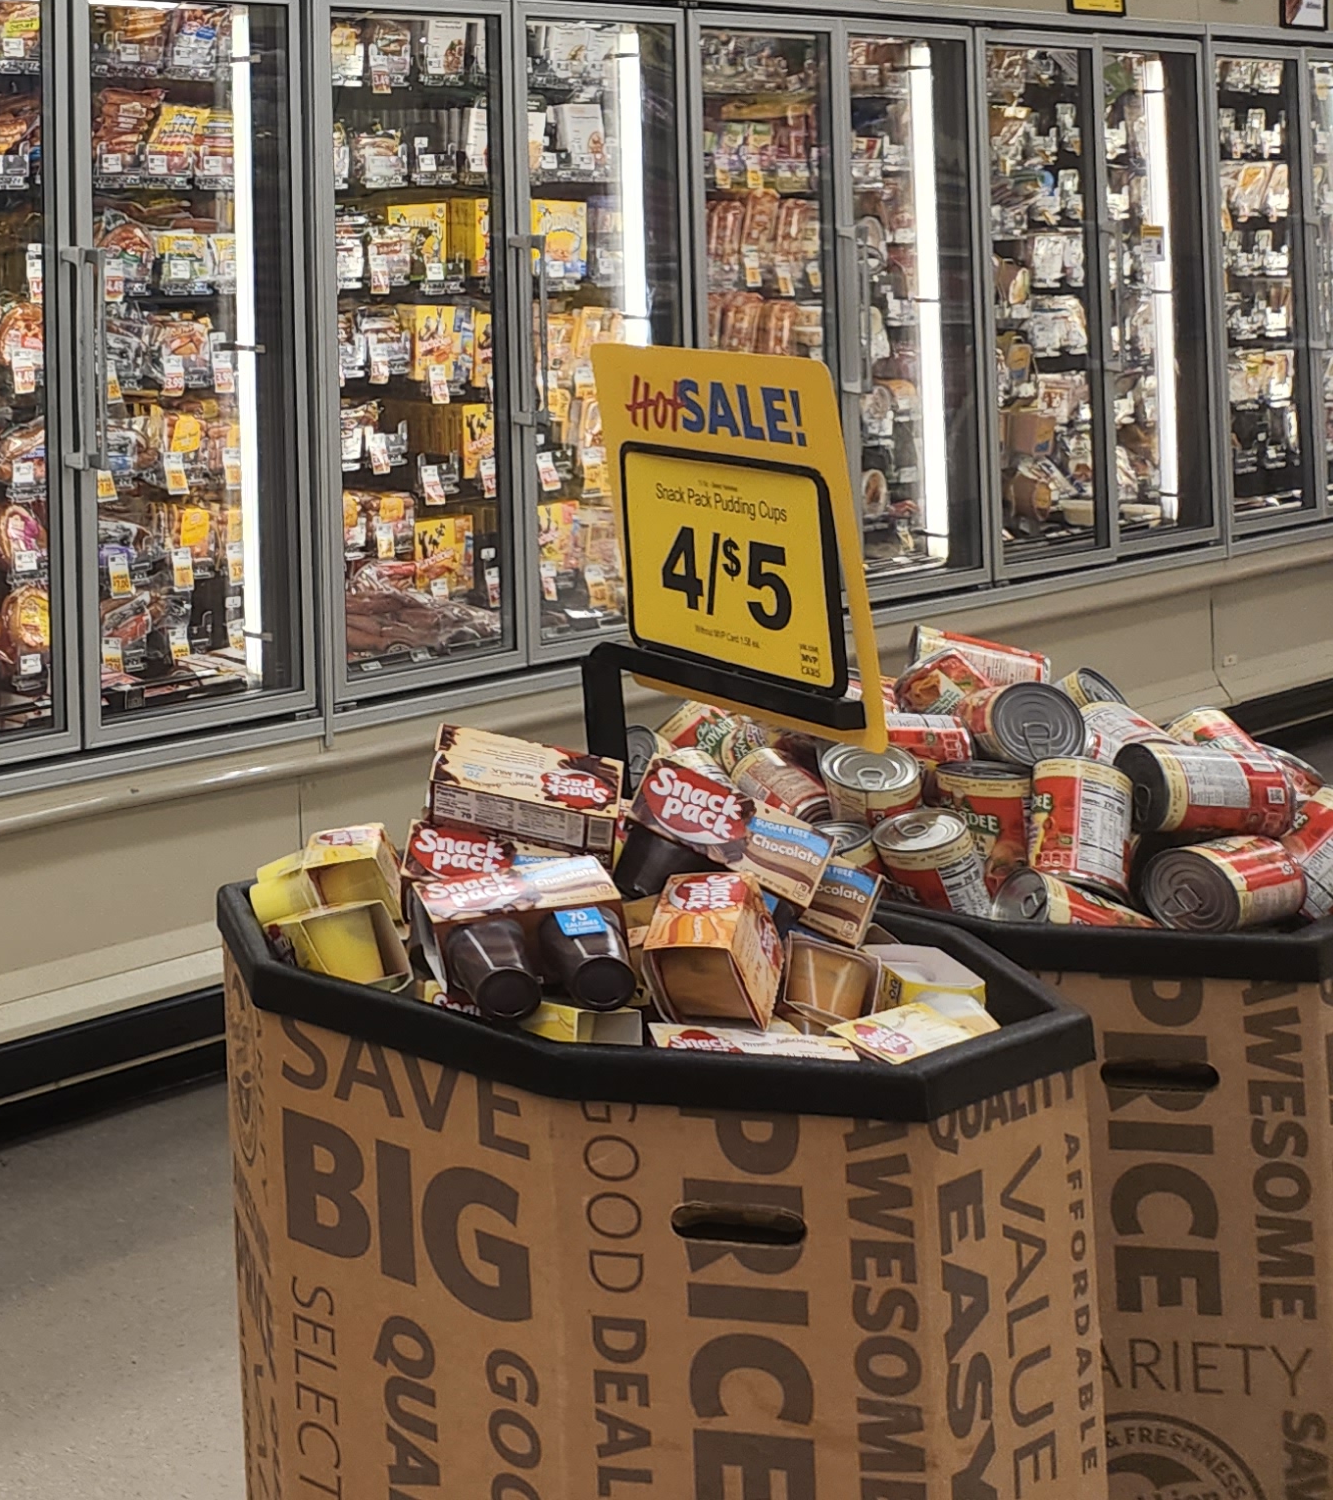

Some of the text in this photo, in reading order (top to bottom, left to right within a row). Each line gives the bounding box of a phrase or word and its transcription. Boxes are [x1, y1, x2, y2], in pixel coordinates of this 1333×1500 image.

[655, 483, 788, 524] Snack Pack Pudding Cups
[546, 782, 610, 803] Snack
[547, 773, 595, 789] pack
[650, 767, 742, 821] Snack
[662, 796, 732, 839] pack
[756, 818, 785, 832] SUGAR
[414, 828, 504, 862] Snack
[432, 850, 501, 874] pack
[752, 835, 823, 867] Chocolate
[426, 870, 512, 899] Snack
[449, 880, 526, 908] pack
[534, 868, 599, 887] Chocolate
[683, 882, 703, 910] pack
[707, 874, 740, 909] Snack
[280, 1014, 531, 1162] SAVE
[1101, 972, 1223, 1317] PRICE
[1241, 977, 1319, 1321] AWESOME
[281, 1106, 533, 1323] BIG
[677, 1107, 818, 1500] PRICE
[998, 1145, 1058, 1500] VALUE
[1063, 1132, 1099, 1476] AFFORDABLE
[937, 1169, 996, 1500] EASY
